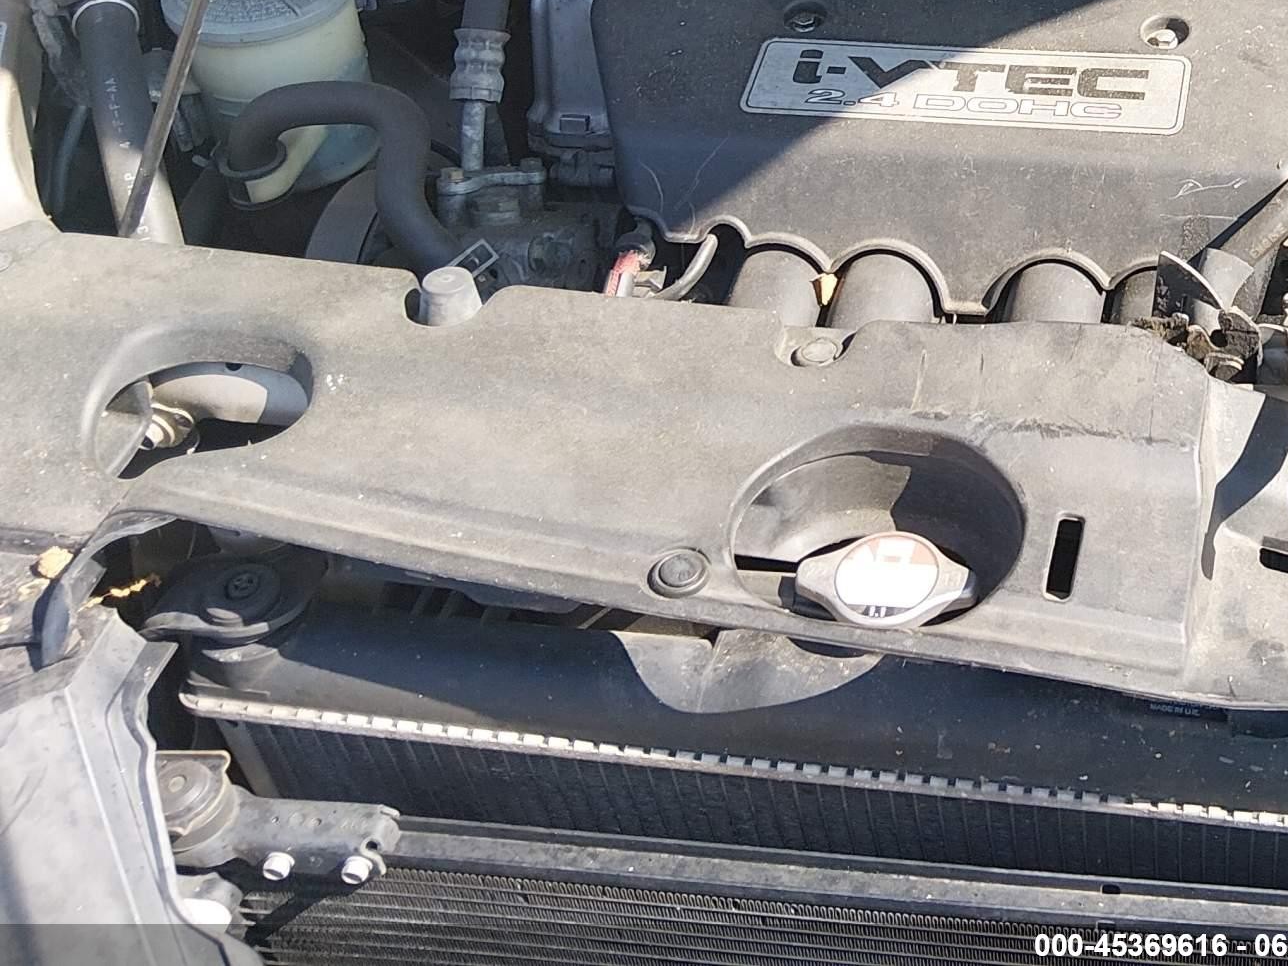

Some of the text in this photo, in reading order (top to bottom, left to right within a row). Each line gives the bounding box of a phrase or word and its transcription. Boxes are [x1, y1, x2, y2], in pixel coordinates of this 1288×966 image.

[791, 48, 1151, 101] i-VTEC
[803, 89, 1123, 120] 2.4 DOHC
